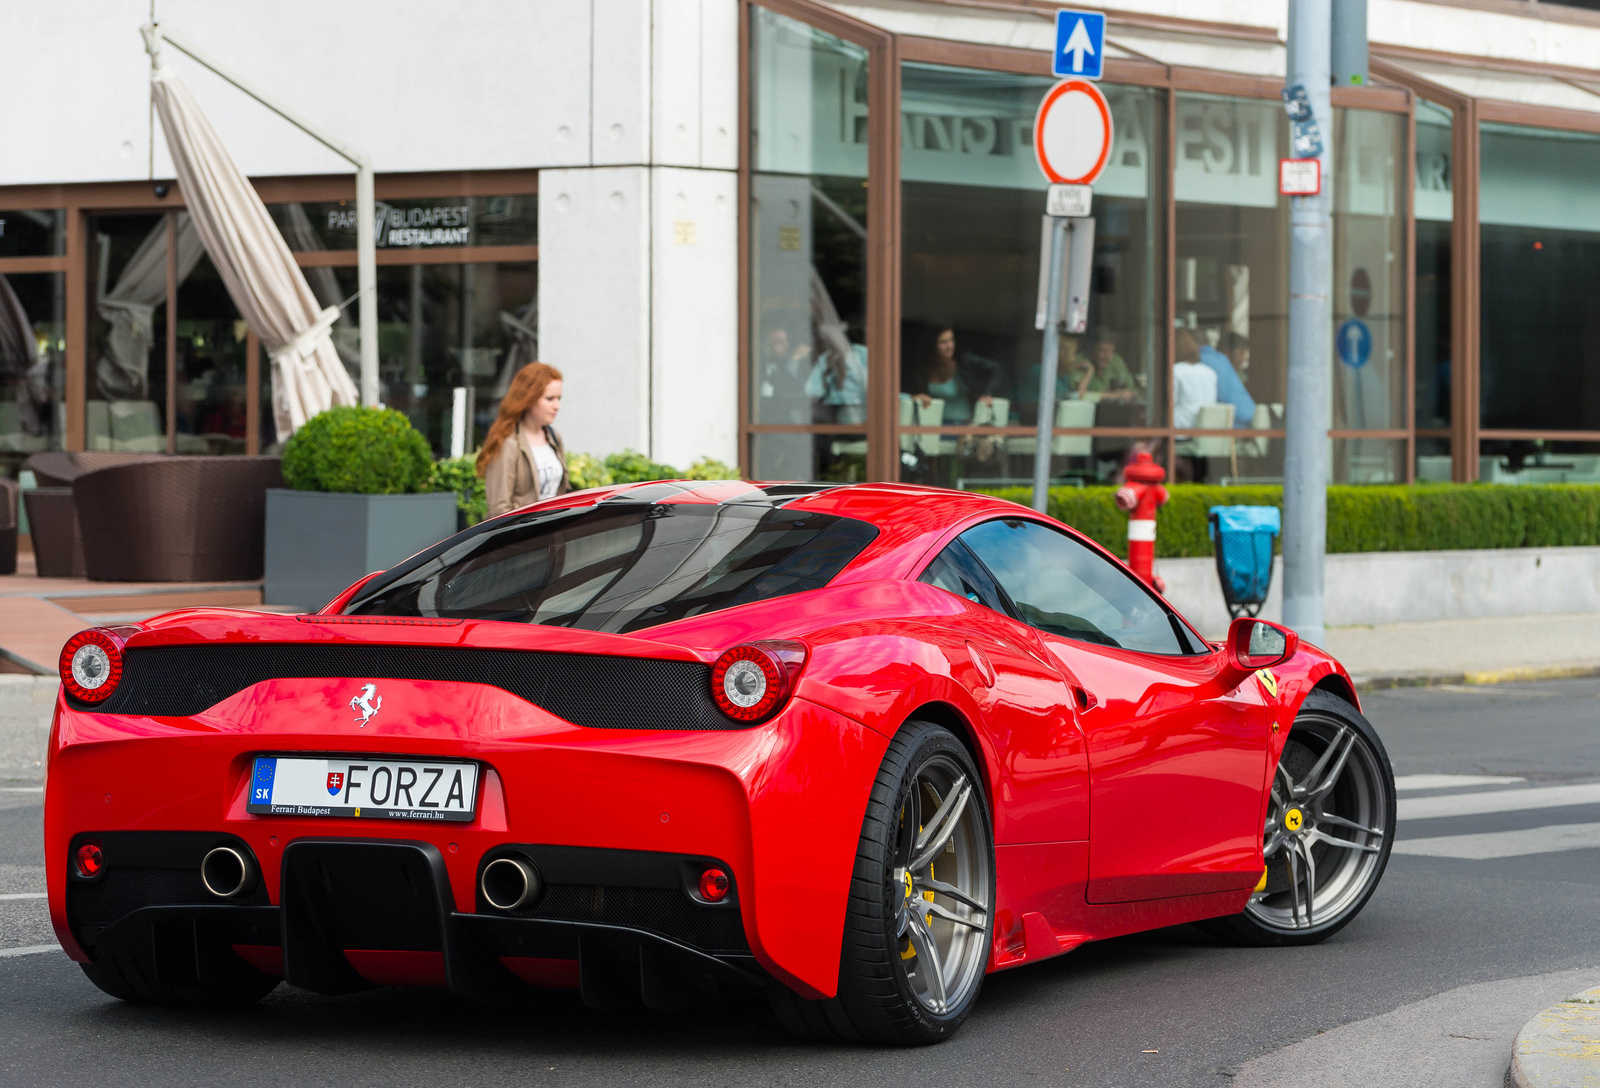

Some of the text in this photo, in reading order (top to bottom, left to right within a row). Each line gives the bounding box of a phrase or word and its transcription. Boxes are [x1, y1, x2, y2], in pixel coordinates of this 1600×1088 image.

[391, 207, 469, 228] BUDAPEST
[388, 227, 470, 245] RESTAURANT
[255, 788, 270, 800] SK
[344, 765, 465, 809] FORZA
[270, 804, 331, 816] Ferrari Budapest
[388, 809, 445, 819] www.ferrari.hu
